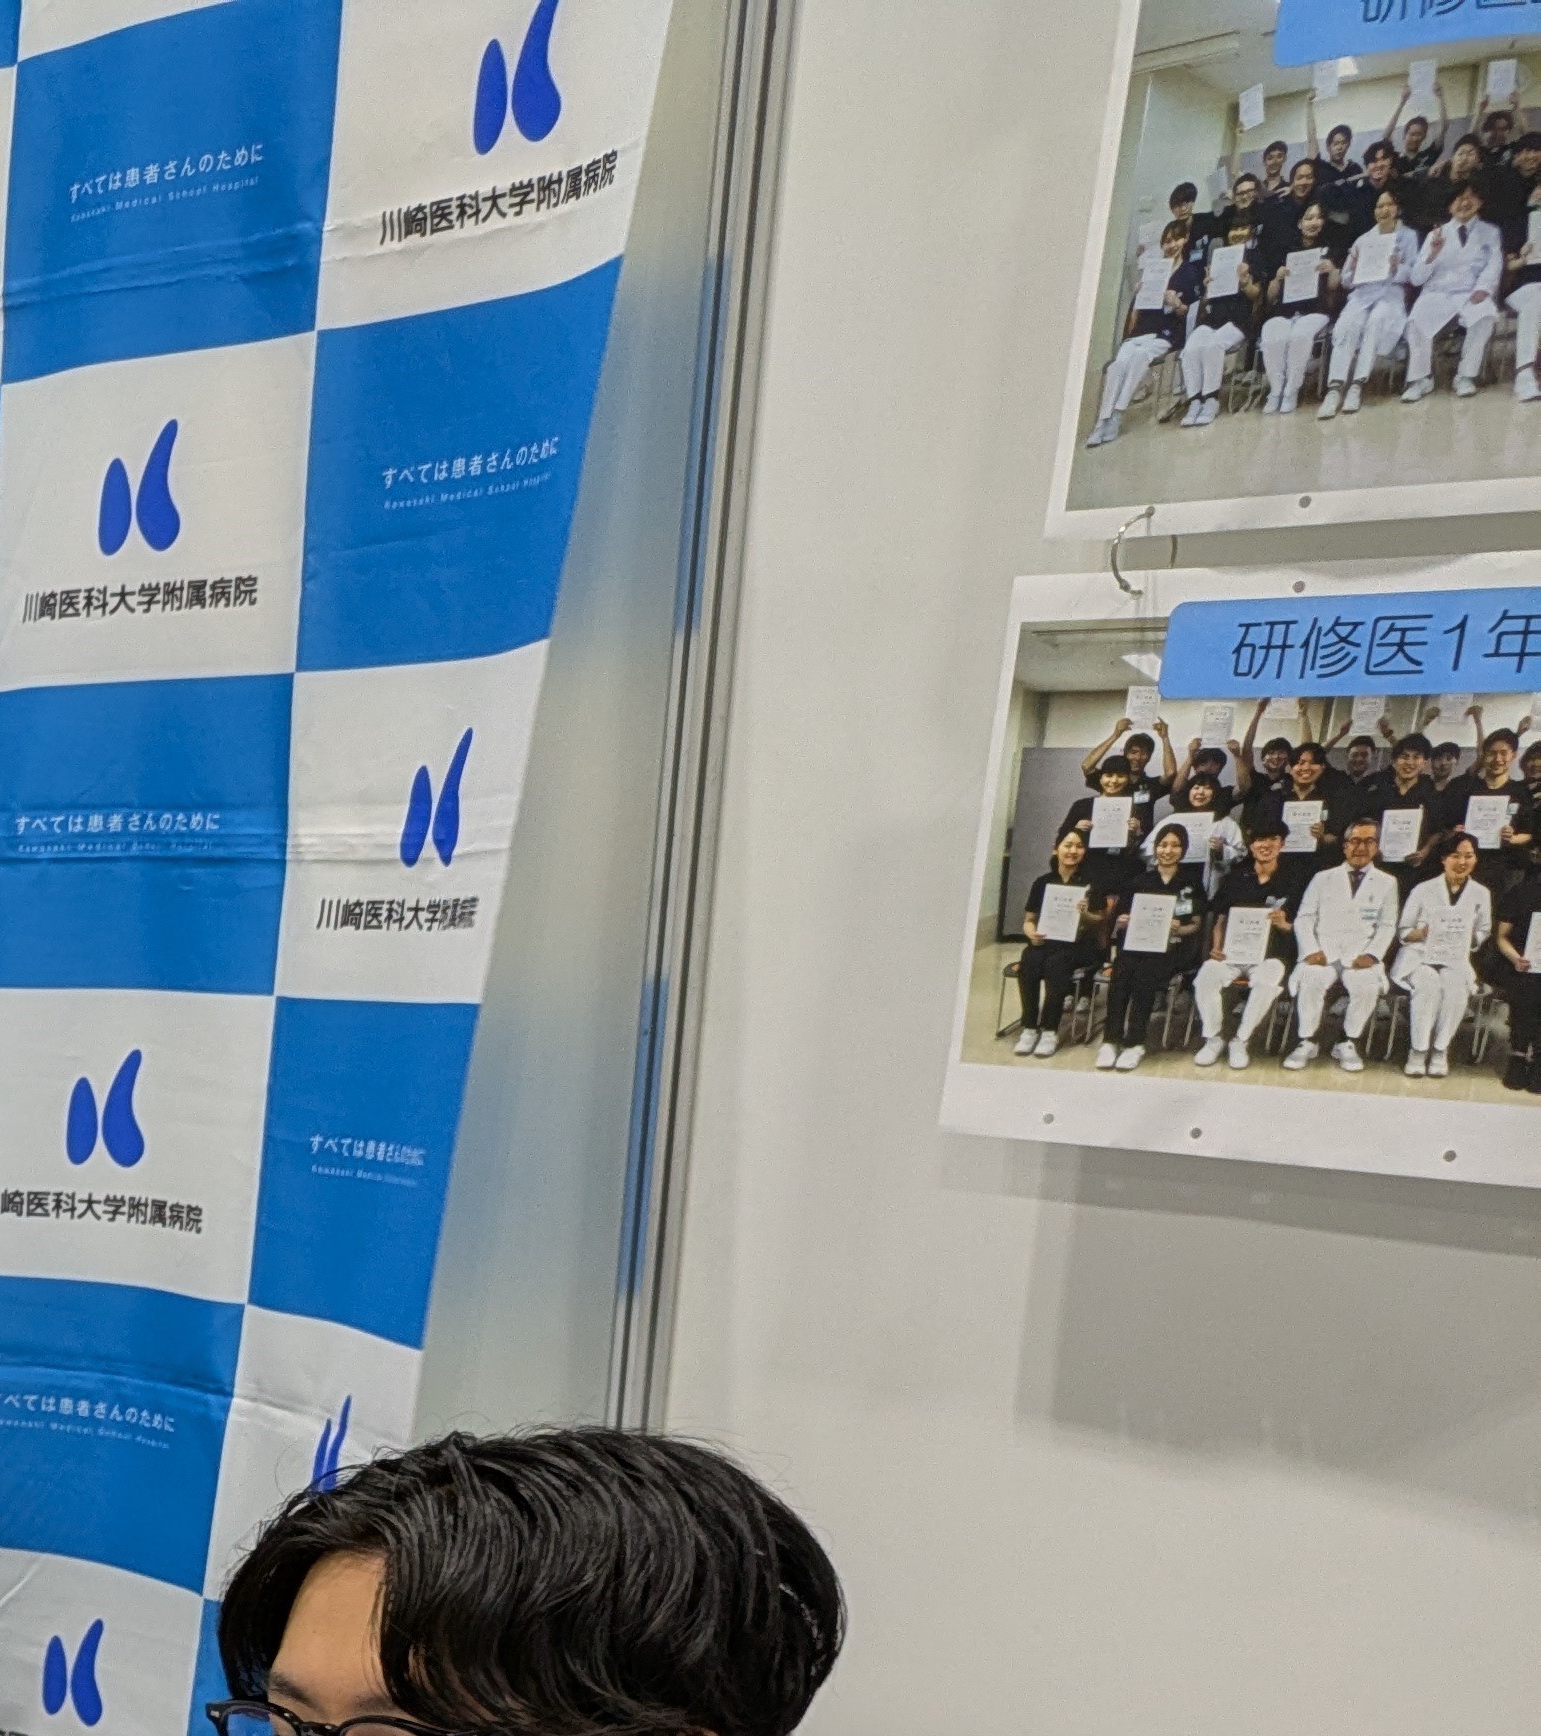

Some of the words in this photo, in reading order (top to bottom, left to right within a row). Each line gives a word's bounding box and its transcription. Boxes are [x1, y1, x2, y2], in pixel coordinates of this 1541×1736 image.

[69, 144, 263, 204] すべては患者さんのために
[380, 149, 617, 245] 川崎医科大学附属病院
[382, 436, 559, 489] すべては患者さんのために
[23, 575, 257, 623] 川崎医科大学附属病院
[16, 812, 221, 835] すべては患者さんのために
